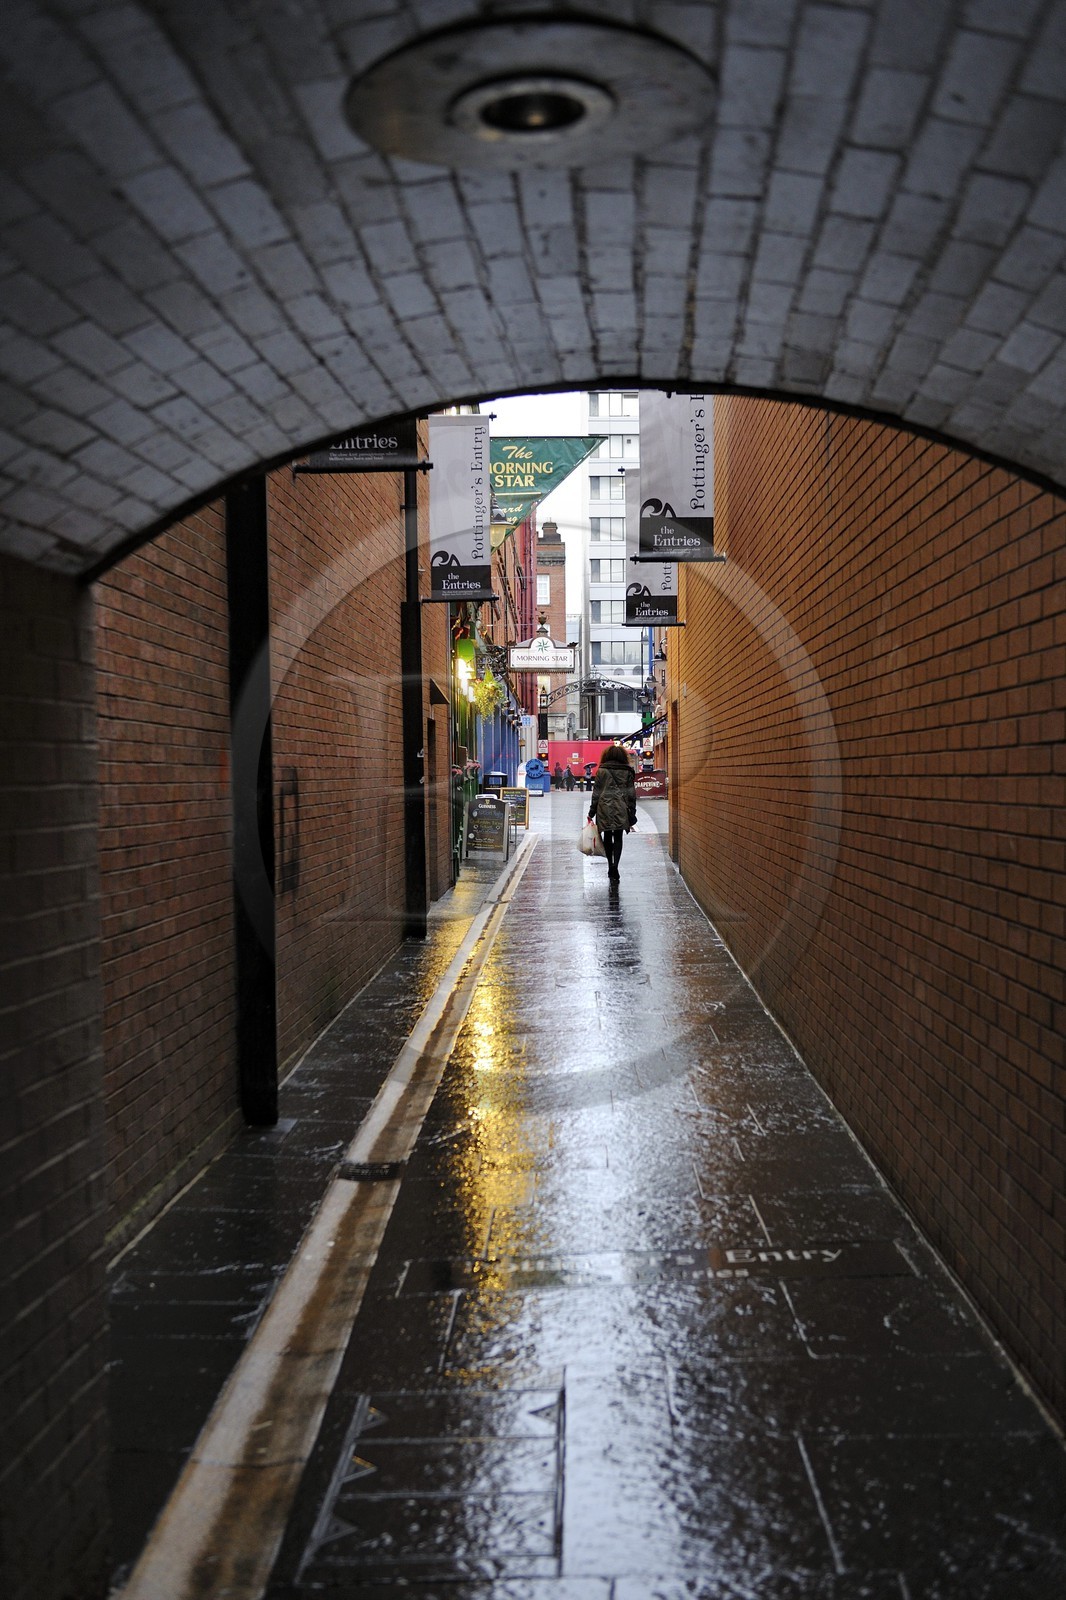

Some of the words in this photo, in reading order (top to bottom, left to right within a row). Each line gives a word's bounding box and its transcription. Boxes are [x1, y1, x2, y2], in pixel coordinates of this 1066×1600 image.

[471, 426, 487, 472] Entry
[502, 445, 533, 459] The
[690, 408, 710, 511] Pottinger's
[494, 475, 535, 488] STAR
[471, 477, 487, 560] Pottinger's
[660, 525, 675, 535] the
[653, 534, 701, 547] Entries
[442, 579, 482, 590] Entries
[634, 607, 669, 617] Entries
[725, 1247, 843, 1265] Entry
